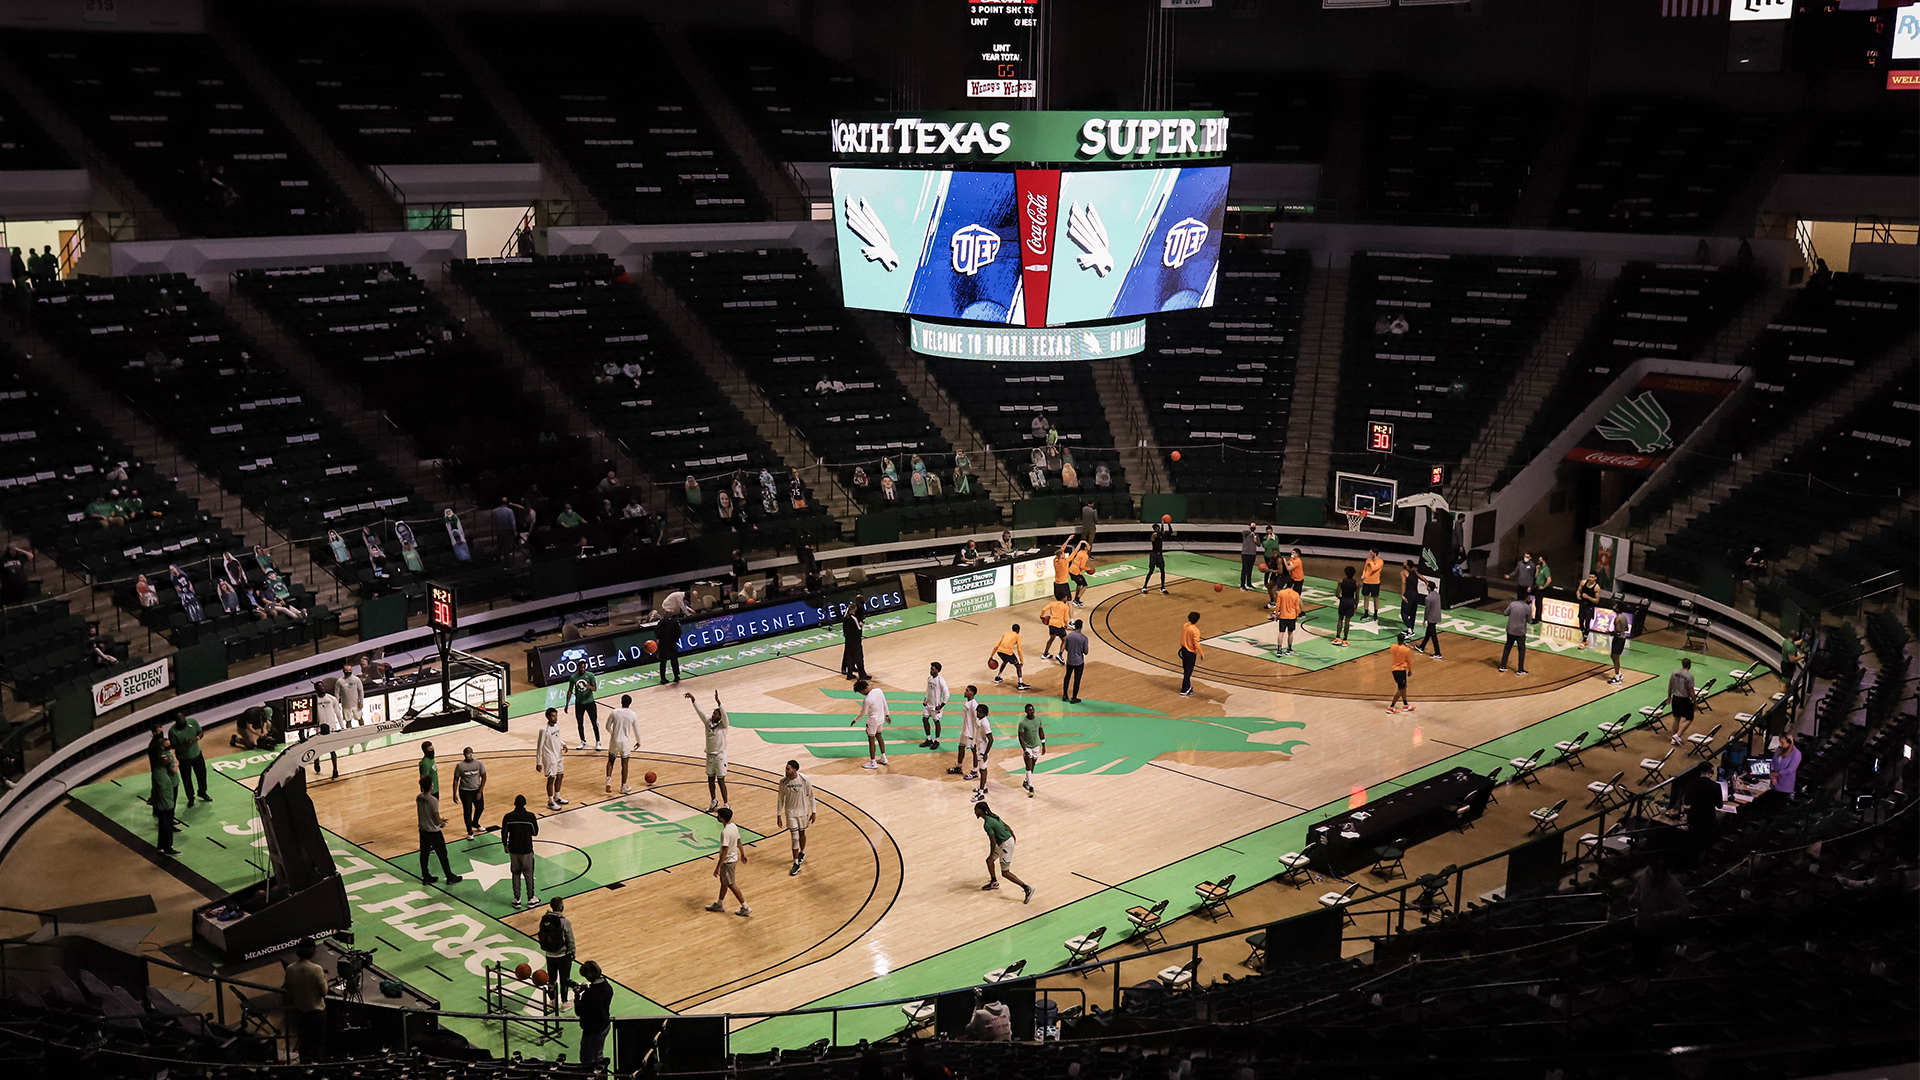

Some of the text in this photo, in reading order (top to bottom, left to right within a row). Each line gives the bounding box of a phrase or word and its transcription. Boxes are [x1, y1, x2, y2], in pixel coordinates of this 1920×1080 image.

[978, 6, 1004, 14] POINT
[970, 18, 989, 26] UNT
[993, 44, 1011, 52] UNT
[981, 53, 1000, 61] YEAR
[831, 118, 1011, 154] NORTH TEXAS
[1080, 117, 1230, 156] SUPER PIT
[1026, 190, 1048, 255] Coca-Cola
[922, 328, 963, 353] WELCOME
[967, 334, 981, 354] TO
[986, 335, 1026, 355] NORTH
[1032, 335, 1072, 356] TEXAS
[1110, 330, 1122, 351] GO
[1373, 433, 1389, 449] 30
[952, 579, 994, 593] PROPERTIES
[432, 588, 452, 603] 14:21
[434, 600, 450, 625] 30
[1543, 603, 1574, 620] FUEGO
[736, 611, 806, 638] RESNET
[123, 665, 163, 687] STUDENT
[124, 676, 162, 697] SECTION
[376, 720, 405, 732] SPALDING
